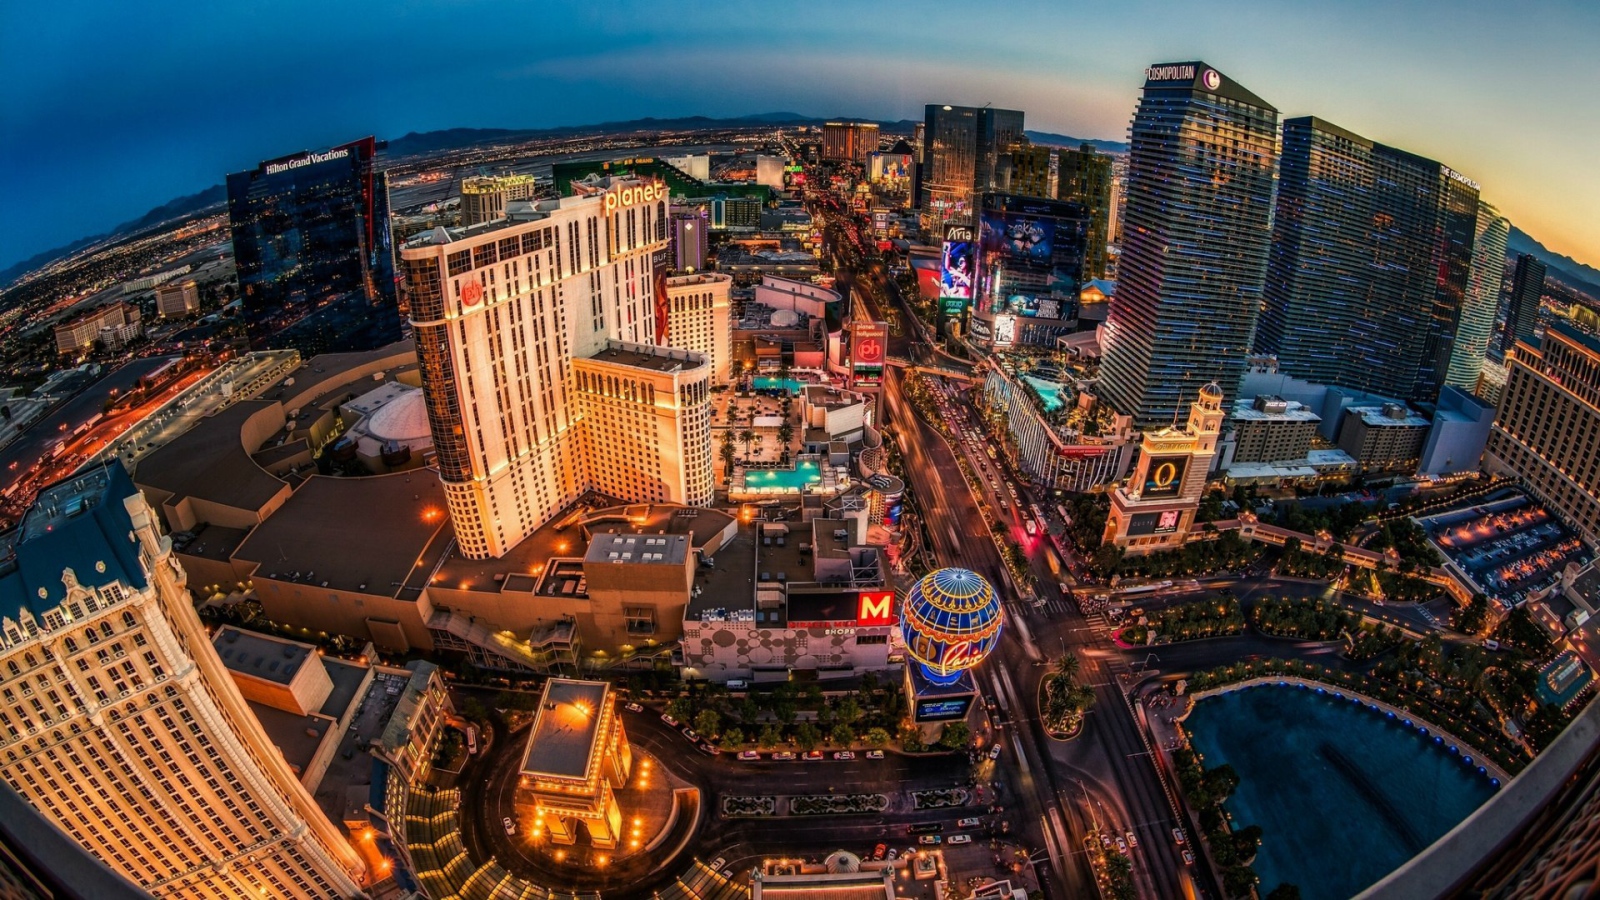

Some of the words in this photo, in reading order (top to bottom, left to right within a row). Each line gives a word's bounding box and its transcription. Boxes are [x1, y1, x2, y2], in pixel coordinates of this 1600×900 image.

[1148, 65, 1195, 80] COSMOPOLITAN
[266, 163, 288, 175] Hilton
[288, 155, 311, 169] Grand
[311, 149, 348, 163] Vacations
[1440, 165, 1450, 177] THE
[1450, 170, 1481, 191] COSMOPOLITAN
[605, 180, 662, 217] planet
[947, 227, 972, 241] Aria
[861, 340, 881, 359] ph
[860, 595, 891, 620] M
[824, 628, 856, 636] SHOPS
[941, 640, 983, 677] Paris
